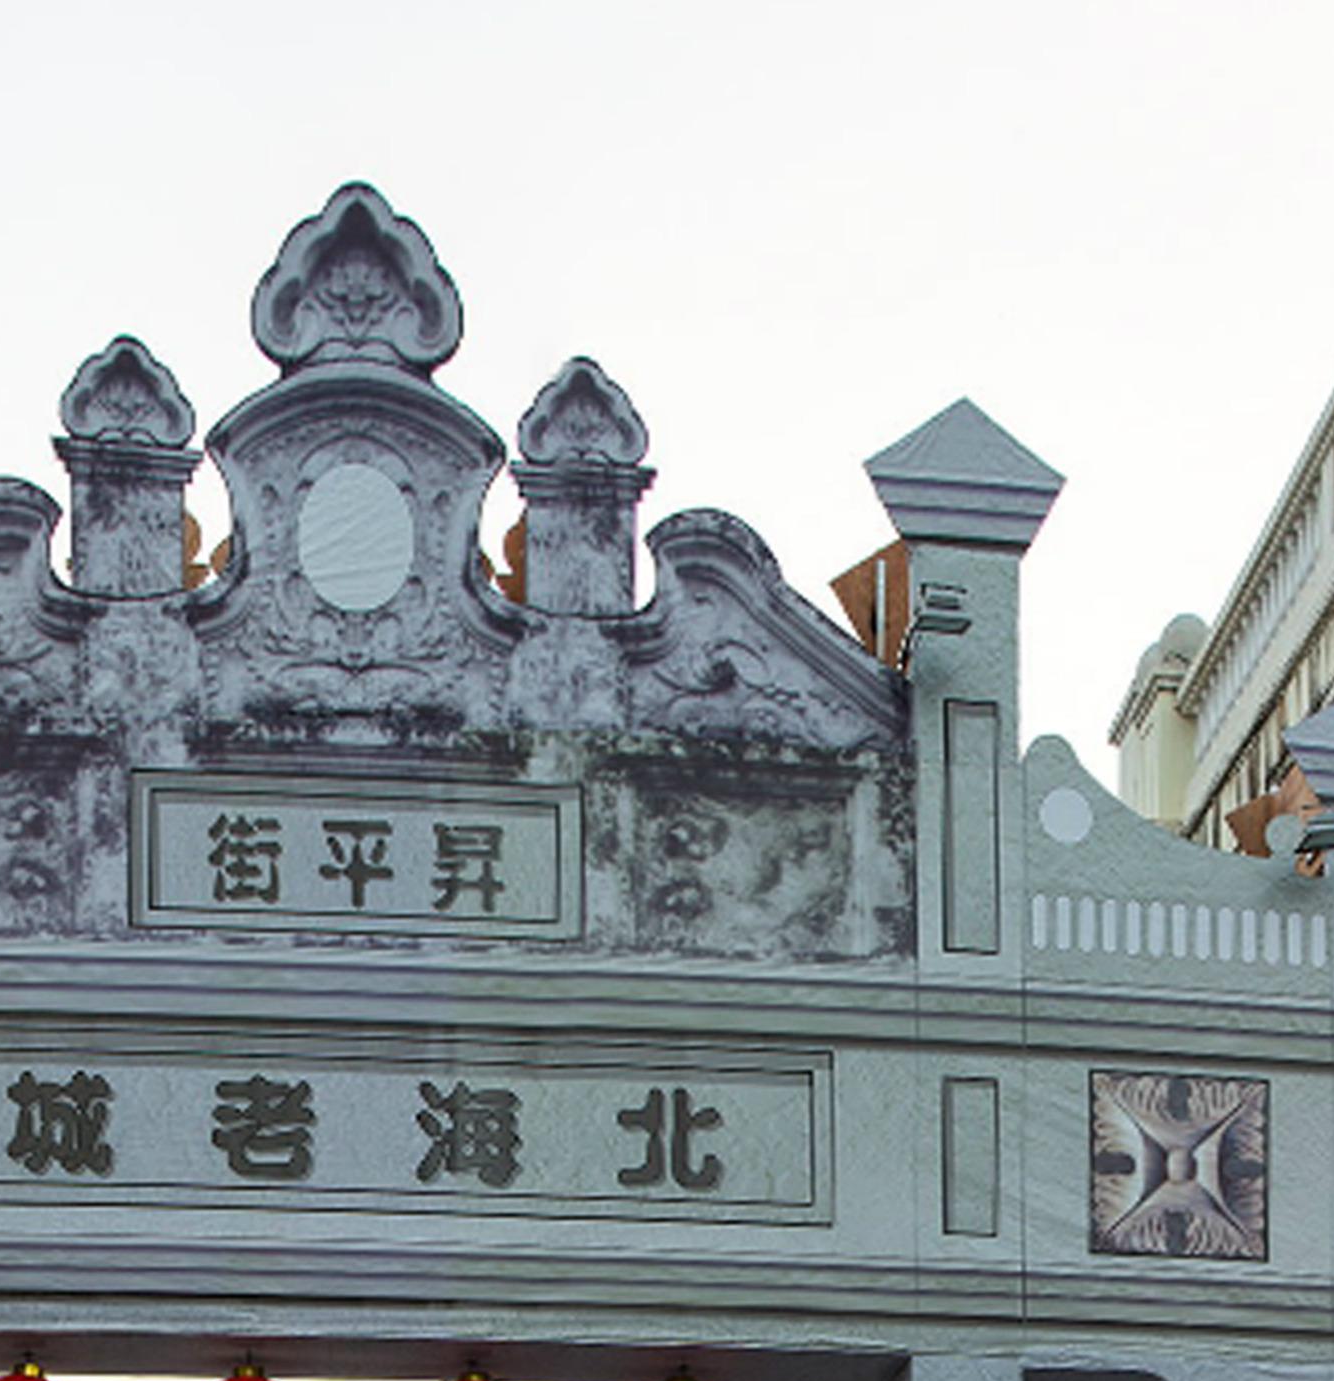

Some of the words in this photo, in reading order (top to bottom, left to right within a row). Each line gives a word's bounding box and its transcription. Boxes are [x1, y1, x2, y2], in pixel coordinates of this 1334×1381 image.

[206, 811, 506, 913] 昇平街
[6, 1070, 724, 1192] 北海老城
